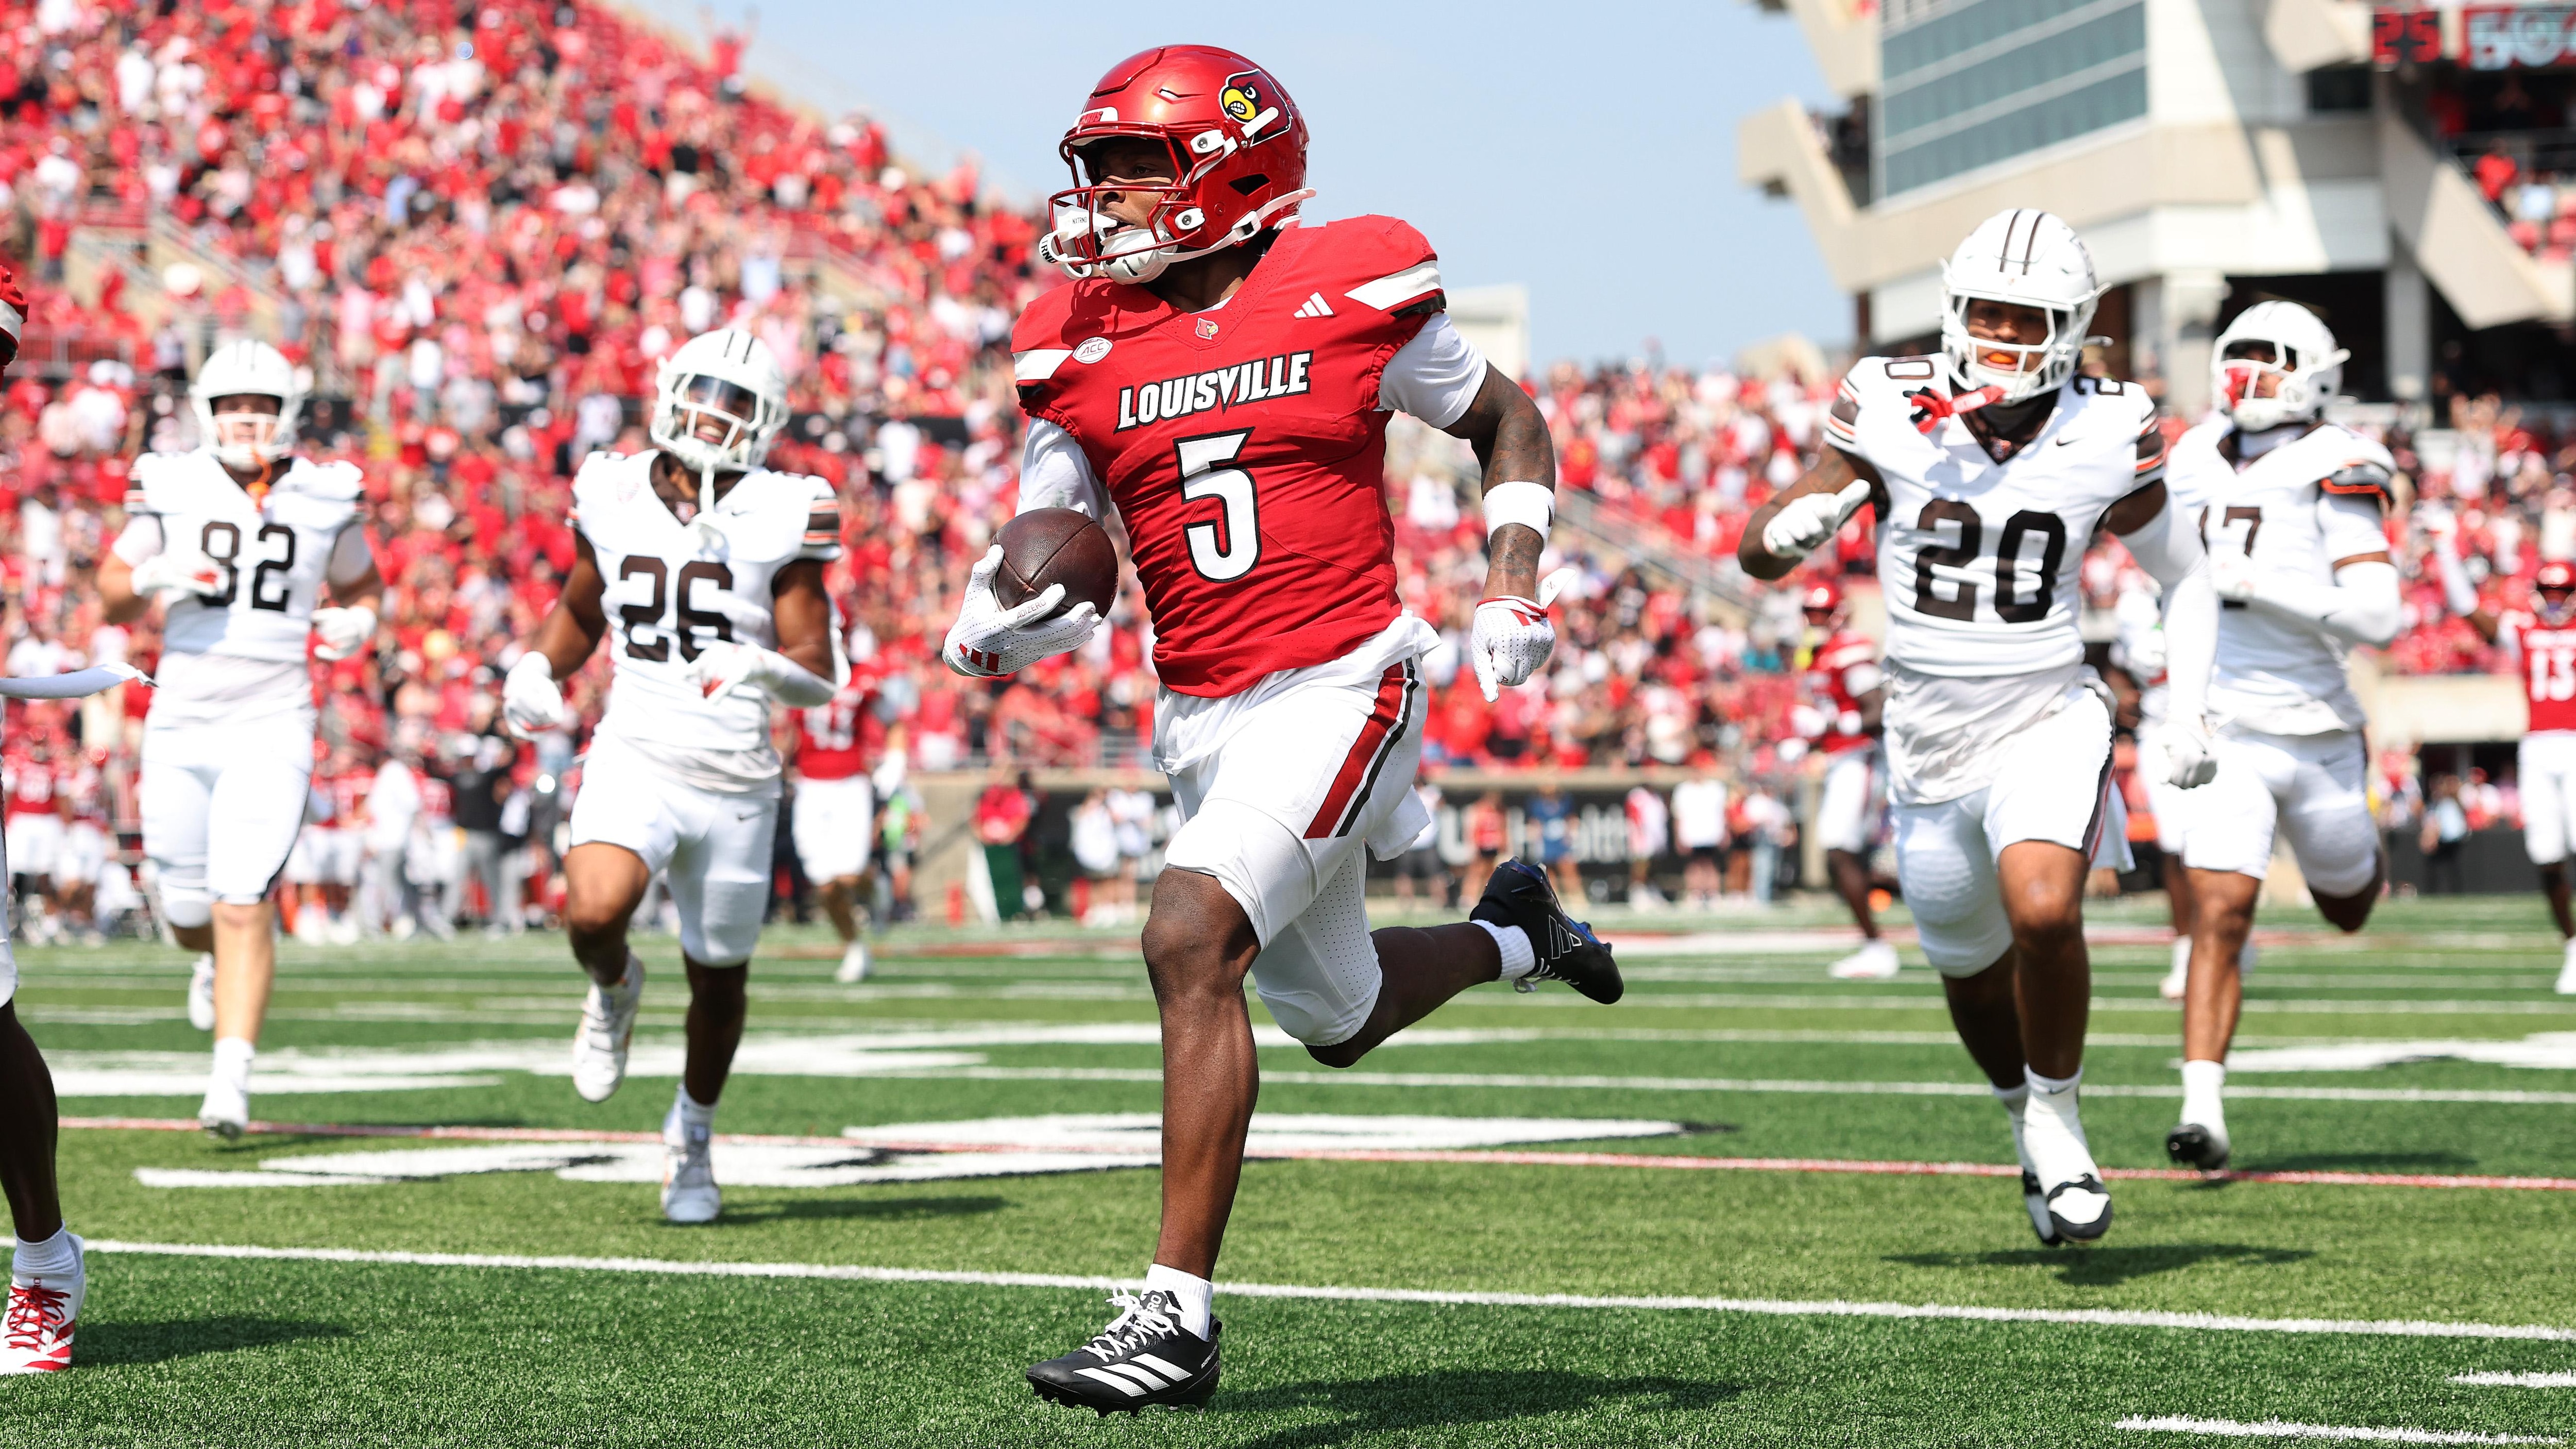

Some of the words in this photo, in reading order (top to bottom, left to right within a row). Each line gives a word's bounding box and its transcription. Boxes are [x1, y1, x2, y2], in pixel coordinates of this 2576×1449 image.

[1072, 216, 1087, 225] NXTRND
[1080, 342, 1105, 356] ACC
[1113, 350, 1313, 434] LOUISVILLE
[1173, 427, 1262, 583] 5
[1915, 498, 2065, 623] 20
[620, 555, 733, 664] 26
[1017, 599, 1046, 620] ADIZERO
[2530, 649, 2576, 702] 13
